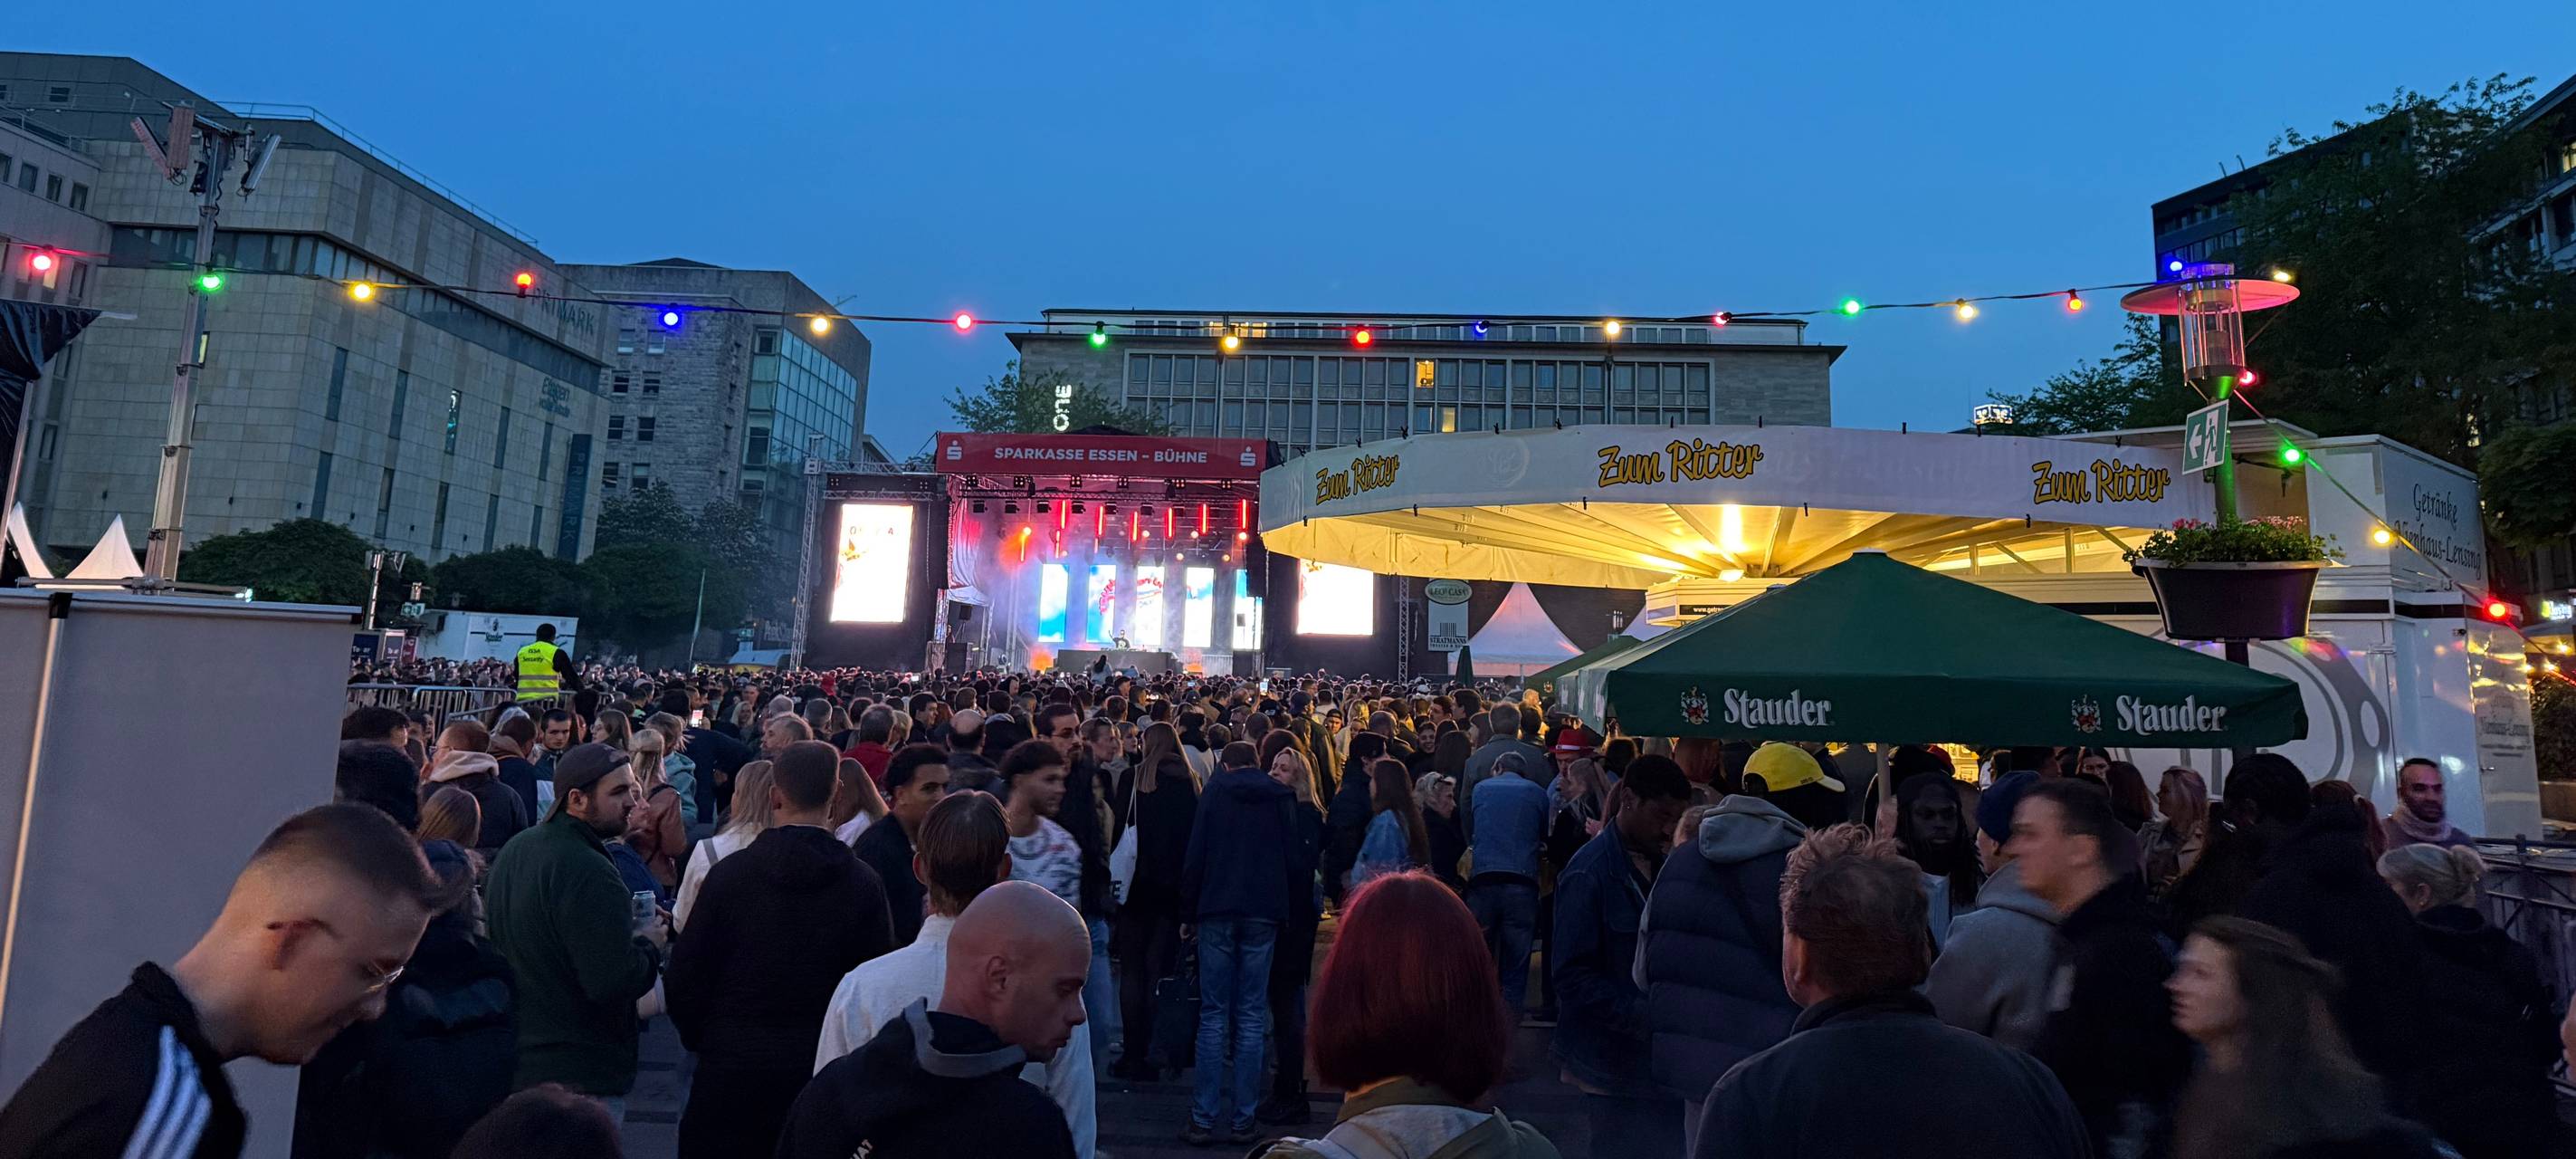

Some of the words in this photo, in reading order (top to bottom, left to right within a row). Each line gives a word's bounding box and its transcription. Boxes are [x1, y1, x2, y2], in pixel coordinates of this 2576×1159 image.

[531, 287, 595, 336] PRIMARK
[994, 447, 1085, 461] SPARKASSE
[1088, 449, 1139, 463] ESSEN
[1153, 449, 1207, 464] BÜHNE
[1598, 445, 1665, 488] Zum
[1665, 437, 1764, 483] Ritter
[561, 453, 587, 541] PRIMARK
[1315, 466, 1351, 506] Zum
[1350, 454, 1400, 496] Ritter
[2031, 460, 2092, 504] Zum
[2090, 458, 2171, 503] Ritter
[2413, 483, 2458, 528] Getränke
[2394, 520, 2482, 580] Nienhaus-Lensing
[1723, 688, 1832, 728] Stauder
[2115, 694, 2228, 736] Stauder
